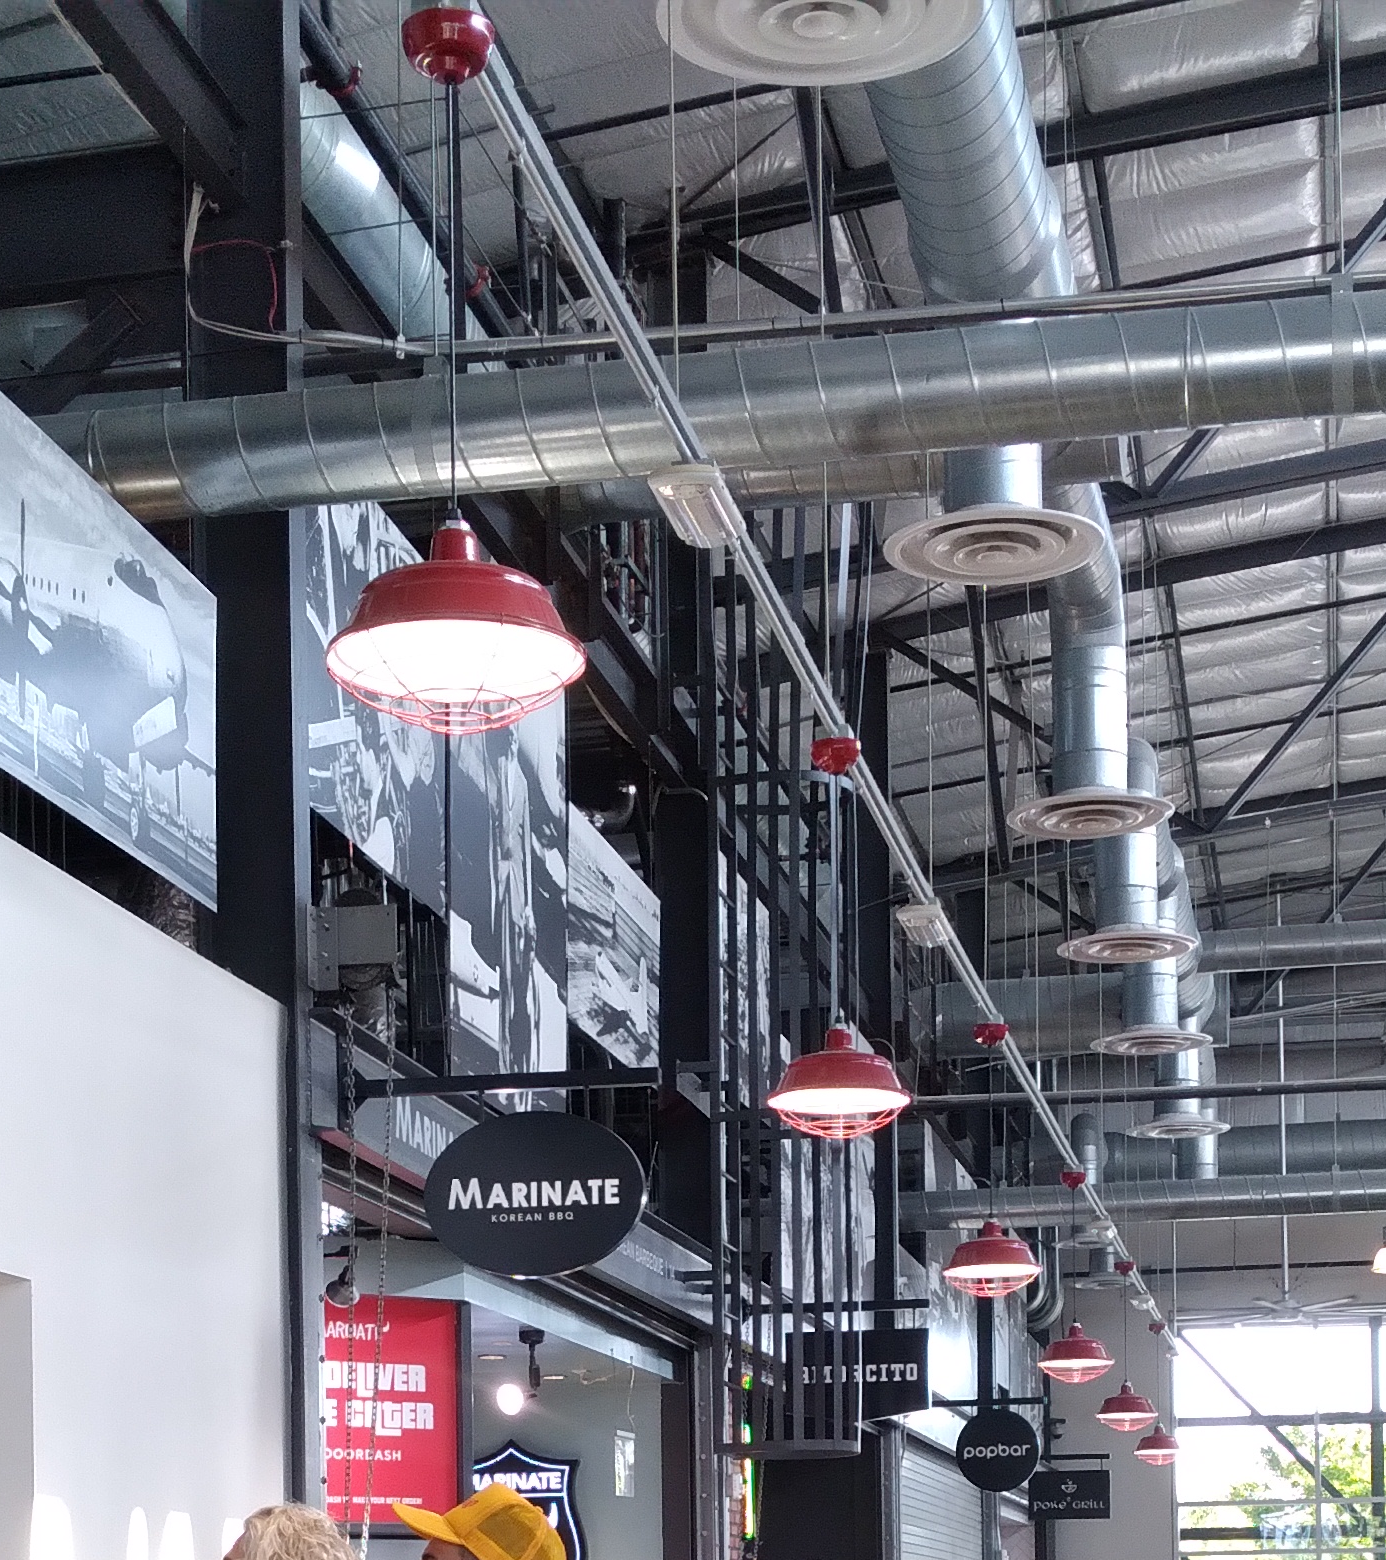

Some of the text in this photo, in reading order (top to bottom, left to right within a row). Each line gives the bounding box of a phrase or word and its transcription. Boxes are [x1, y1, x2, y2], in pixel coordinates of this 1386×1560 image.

[448, 1178, 620, 1211] MARINATE
[491, 1210, 575, 1223] KOREAN BBQ
[964, 1443, 1031, 1459] popbar
